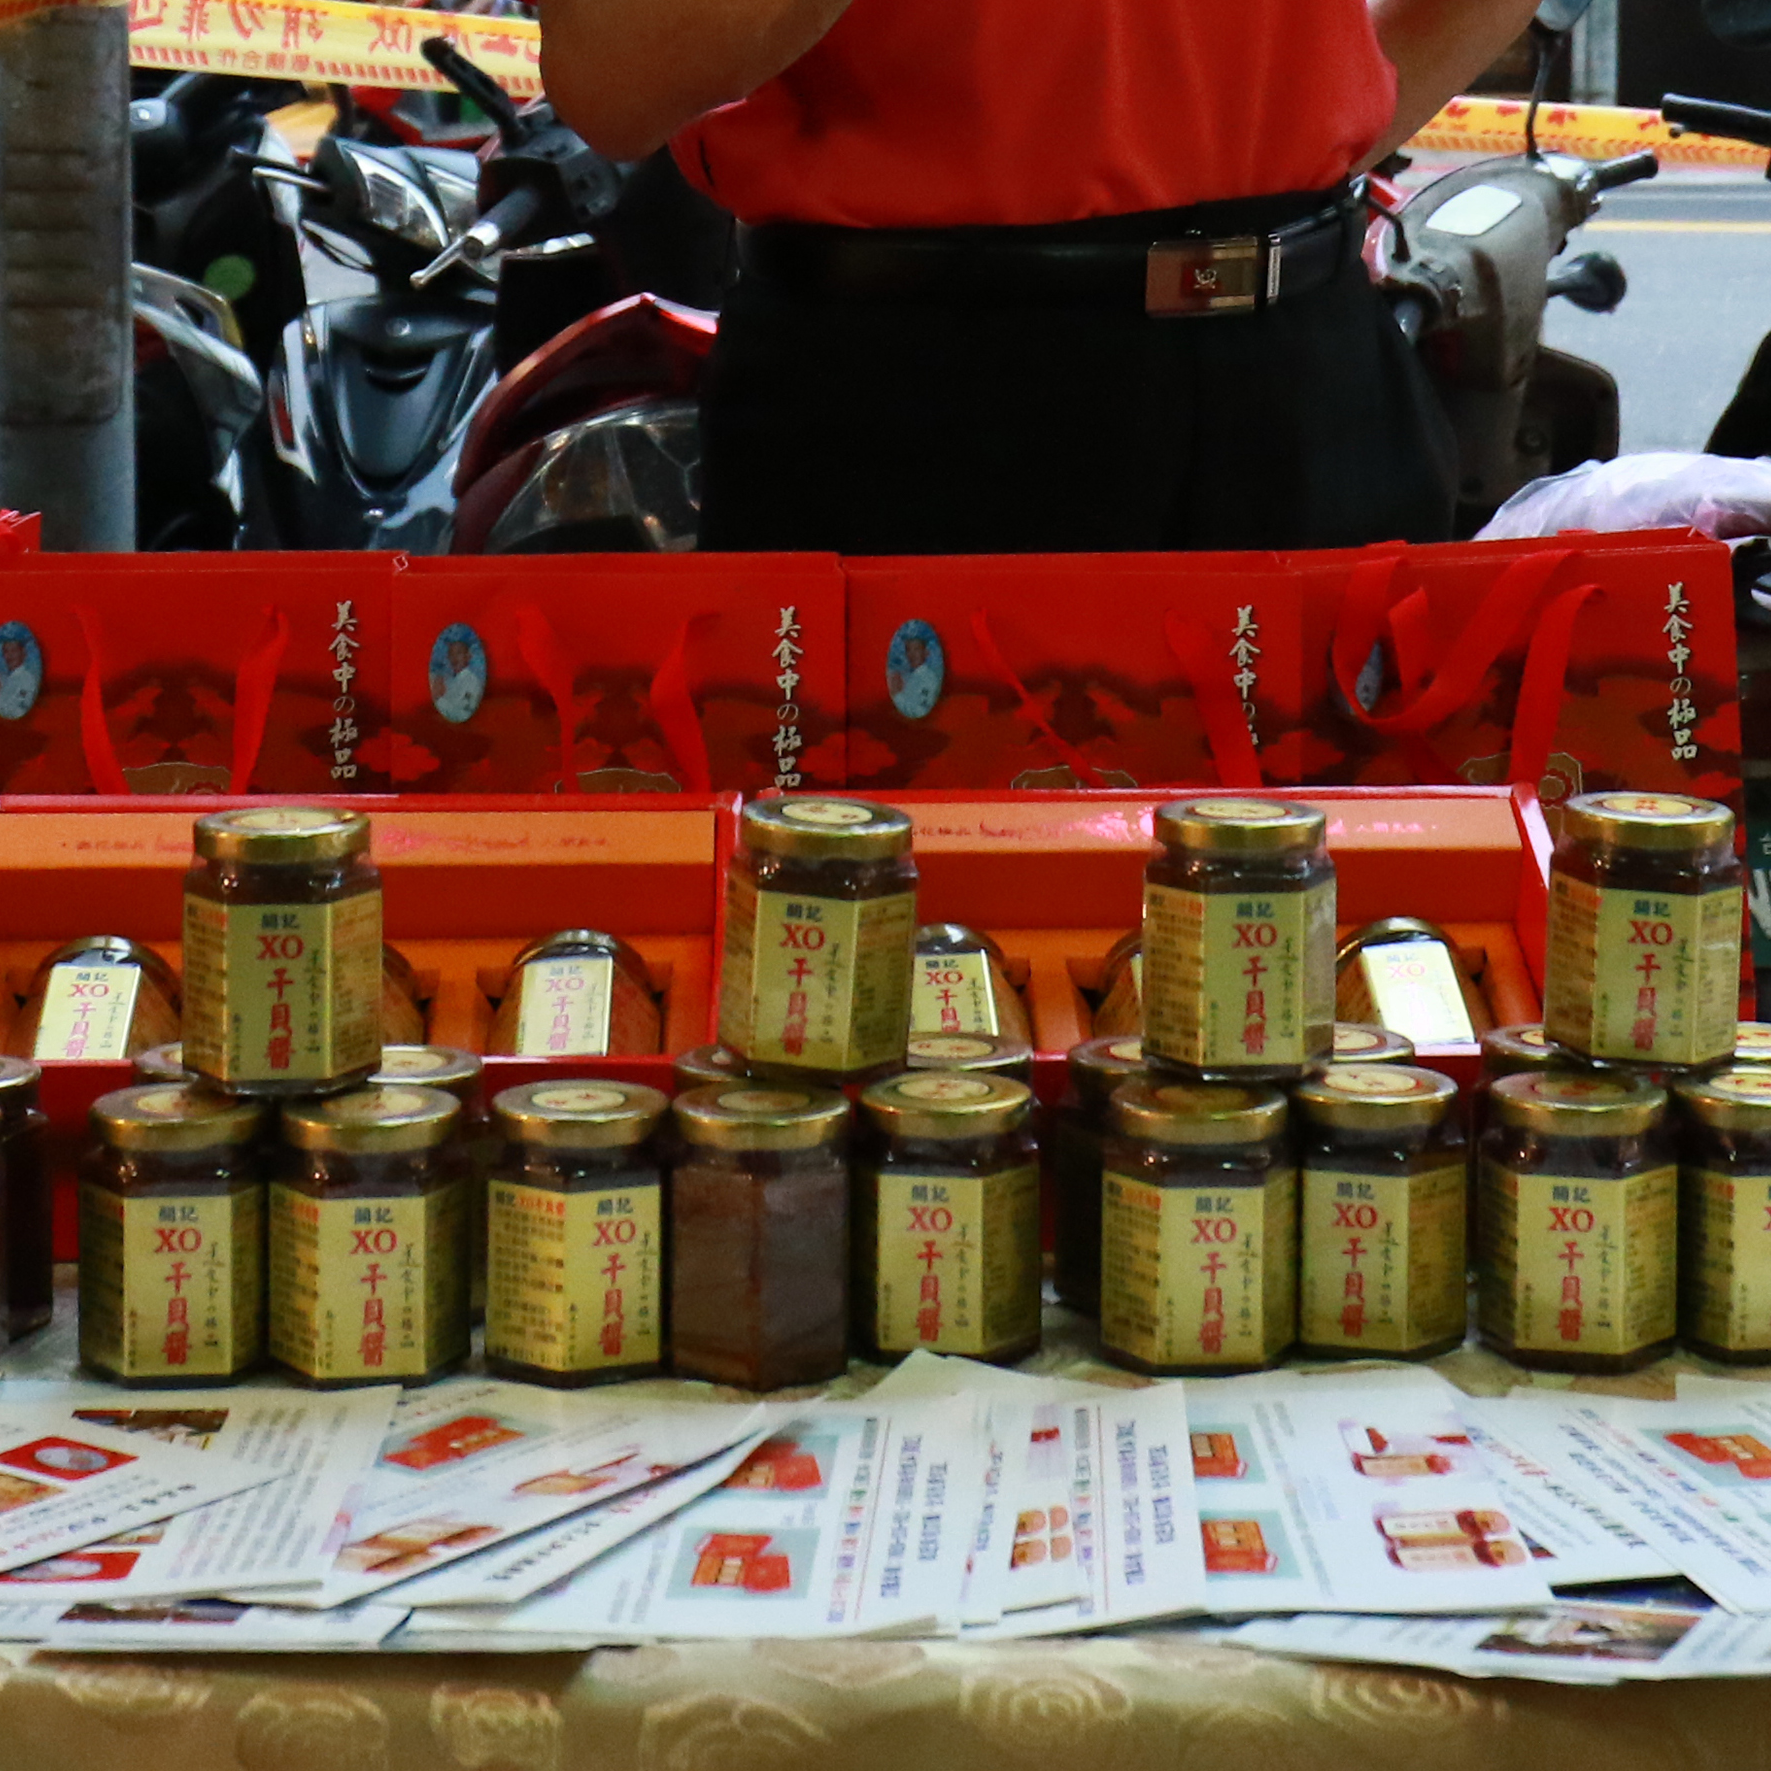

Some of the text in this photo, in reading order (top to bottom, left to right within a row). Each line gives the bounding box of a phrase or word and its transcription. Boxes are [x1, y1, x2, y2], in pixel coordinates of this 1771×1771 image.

[779, 923, 826, 952] XO
[1232, 924, 1278, 949] XO
[1628, 920, 1673, 946] XO
[256, 934, 305, 960] XO
[925, 970, 964, 985] XO
[1387, 963, 1426, 979] XO
[67, 983, 111, 998] XO
[545, 977, 586, 993] XO
[907, 1206, 953, 1234] XO
[1332, 1203, 1378, 1229] XO
[1548, 1207, 1595, 1233] XO
[153, 1228, 202, 1254] XO
[349, 1229, 398, 1256] XO
[592, 1219, 637, 1248] XO
[1191, 1218, 1238, 1244] XO
